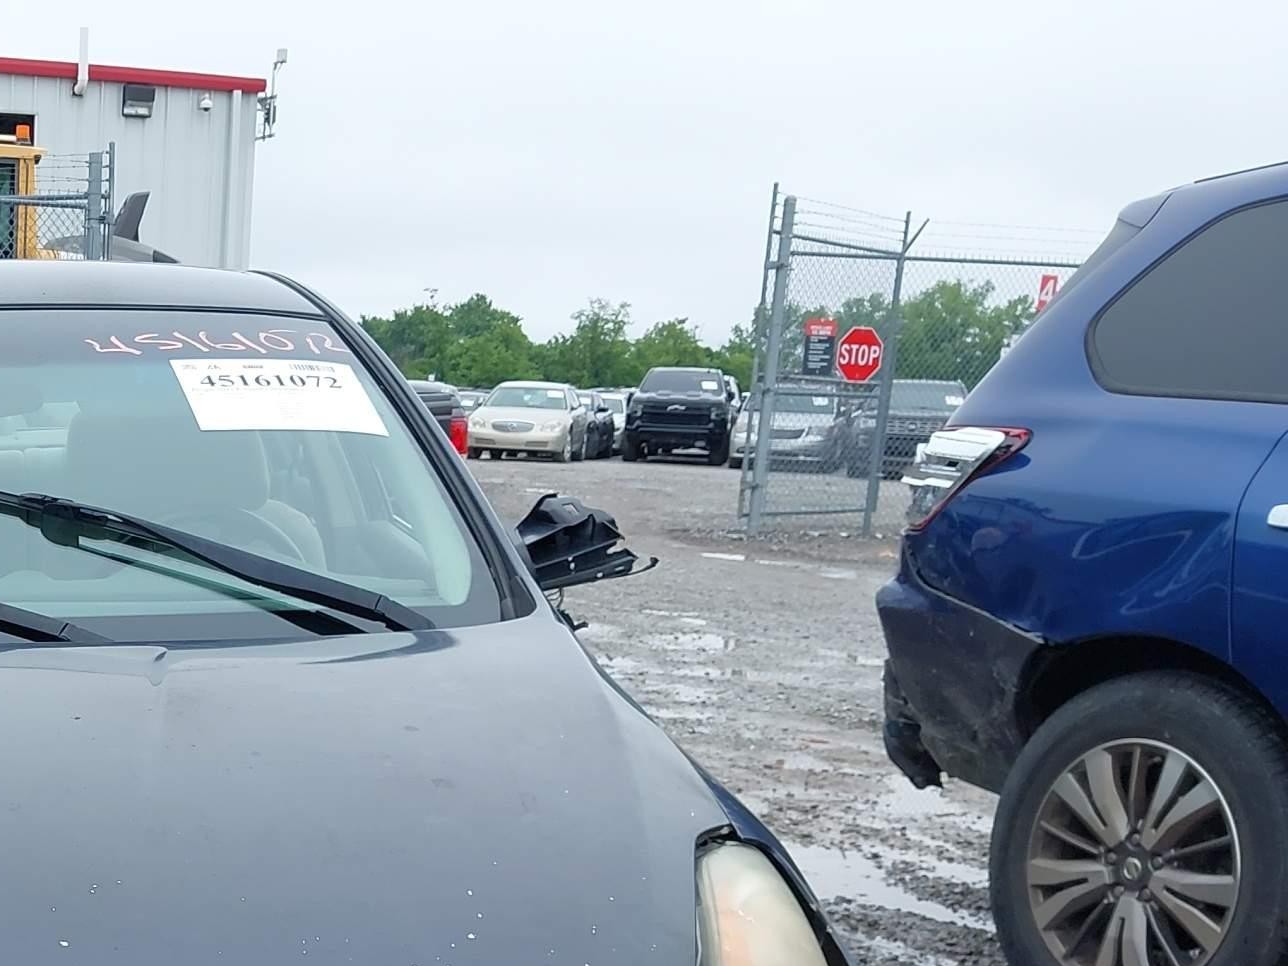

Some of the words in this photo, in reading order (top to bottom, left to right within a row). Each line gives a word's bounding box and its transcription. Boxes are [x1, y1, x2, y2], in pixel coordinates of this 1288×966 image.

[1039, 279, 1056, 304] 4
[839, 343, 880, 366] STOP
[200, 374, 343, 389] 45161072
